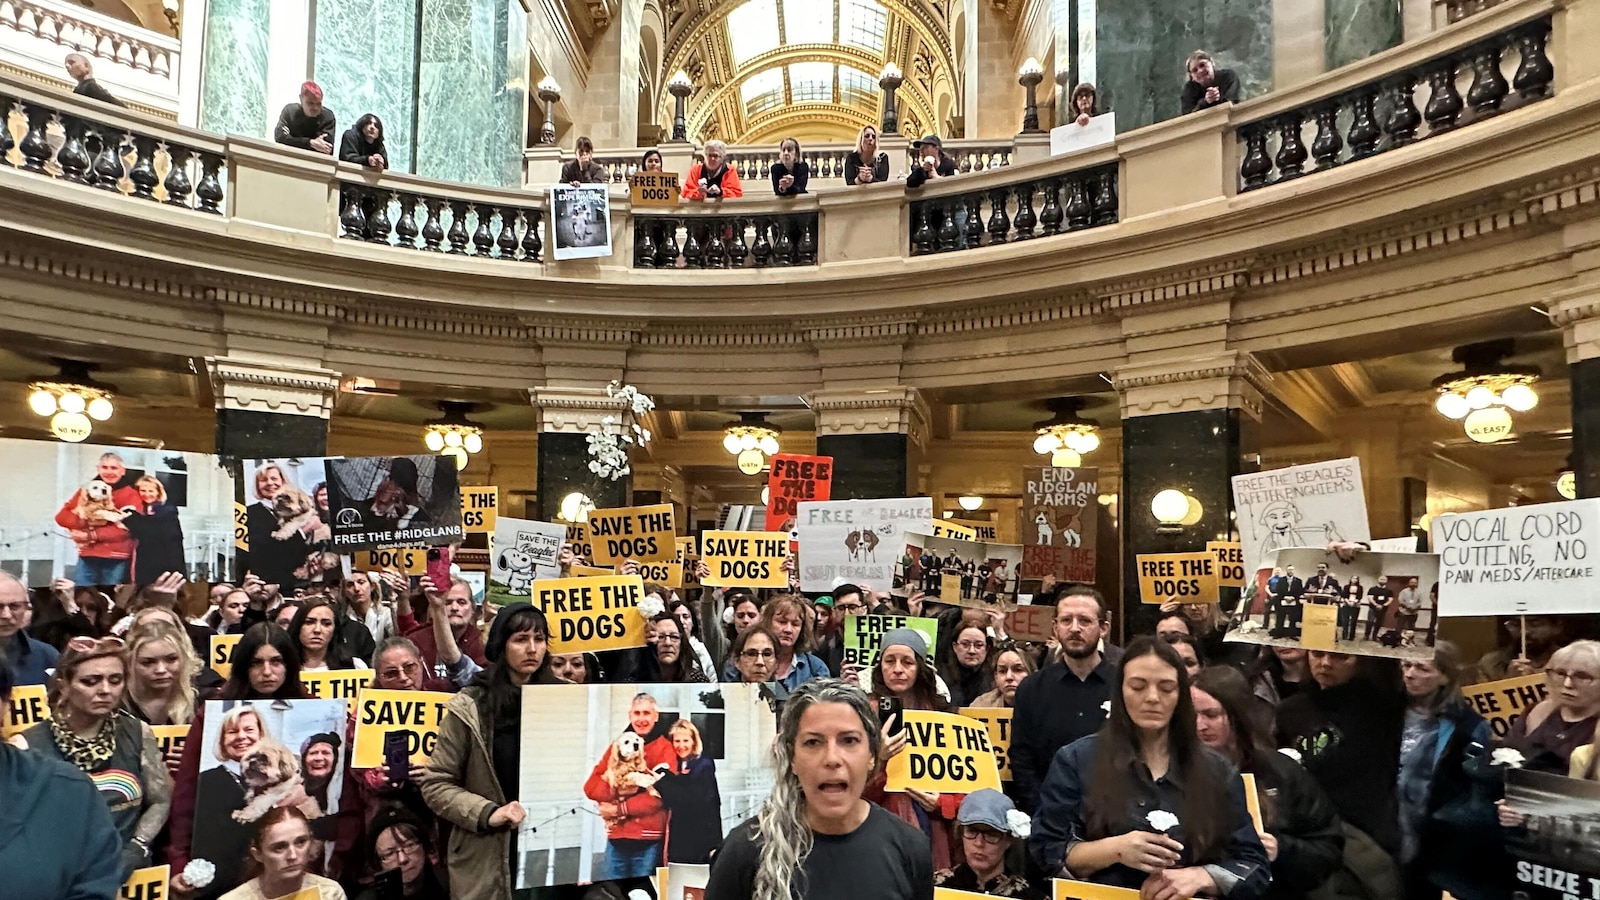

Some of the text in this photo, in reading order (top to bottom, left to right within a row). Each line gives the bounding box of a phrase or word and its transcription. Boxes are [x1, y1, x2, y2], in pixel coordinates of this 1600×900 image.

[634, 175, 677, 187] FREE THE
[642, 188, 669, 200] DOGS
[1483, 426, 1506, 434] EAST
[773, 459, 830, 480] FREE
[1042, 468, 1075, 482] END
[780, 480, 815, 499] THE
[1027, 480, 1097, 494] RIDGLAN
[1236, 476, 1266, 491] FREE
[1268, 474, 1289, 487] THE
[469, 493, 495, 508] THE
[773, 496, 797, 516] DO
[1033, 492, 1088, 507] FARMS
[463, 511, 483, 526] GS
[590, 512, 672, 536] SAVE THE
[808, 508, 853, 525] FREE
[334, 525, 460, 545] FREE THE #RIDGLAN8
[1440, 511, 1582, 542] VOCAL CORD
[518, 534, 558, 546] SAVE THE
[607, 537, 657, 558] DOGS
[705, 538, 748, 556] SAVE
[755, 539, 786, 557] THE
[1024, 545, 1094, 566] FREE THE
[1442, 539, 1586, 567] CUTTING, NO
[639, 565, 668, 580] OGS
[721, 561, 770, 579] DOGS
[1142, 560, 1212, 576] FREE THE
[1222, 565, 1244, 580] DO
[1445, 569, 1474, 584] PAIN
[1154, 580, 1200, 596] DOGS
[540, 585, 639, 614] FREE THE
[560, 614, 626, 642] DOGS
[856, 615, 907, 633] FREE
[857, 632, 882, 650] TH
[10, 697, 44, 726] HE
[362, 700, 426, 725] SAVE
[903, 722, 947, 748] AVE
[952, 725, 990, 753] THE
[910, 753, 978, 781] DOGS
[1516, 861, 1580, 895] SEIZE
